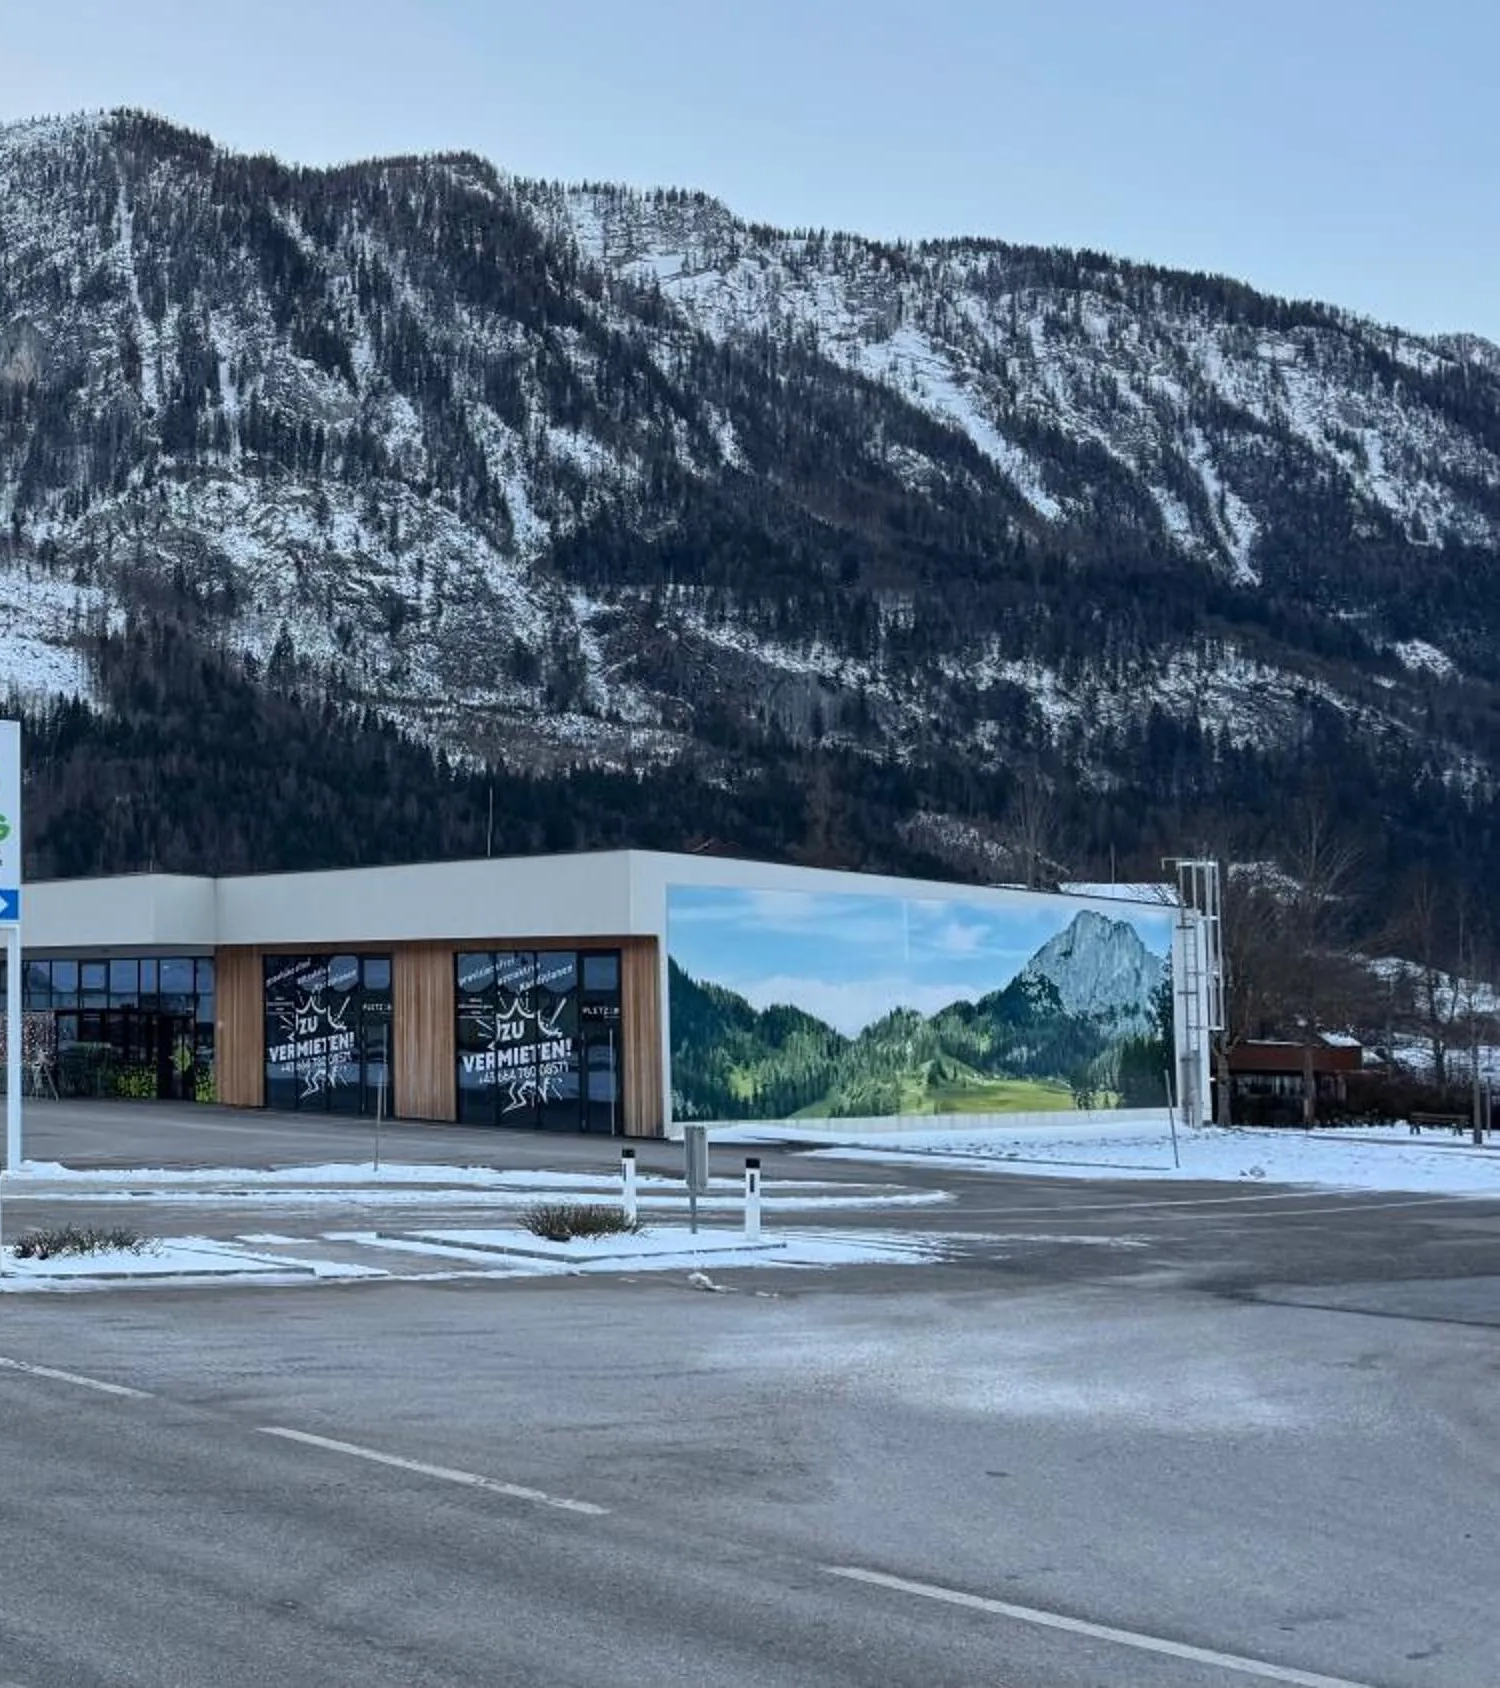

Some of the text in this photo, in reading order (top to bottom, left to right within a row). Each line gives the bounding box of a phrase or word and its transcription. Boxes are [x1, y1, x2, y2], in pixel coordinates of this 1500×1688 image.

[300, 1016, 318, 1035] ZU
[501, 1021, 525, 1041] ZU
[269, 1031, 355, 1062] VERMIETEN!
[462, 1038, 572, 1073] VERMIETEN!
